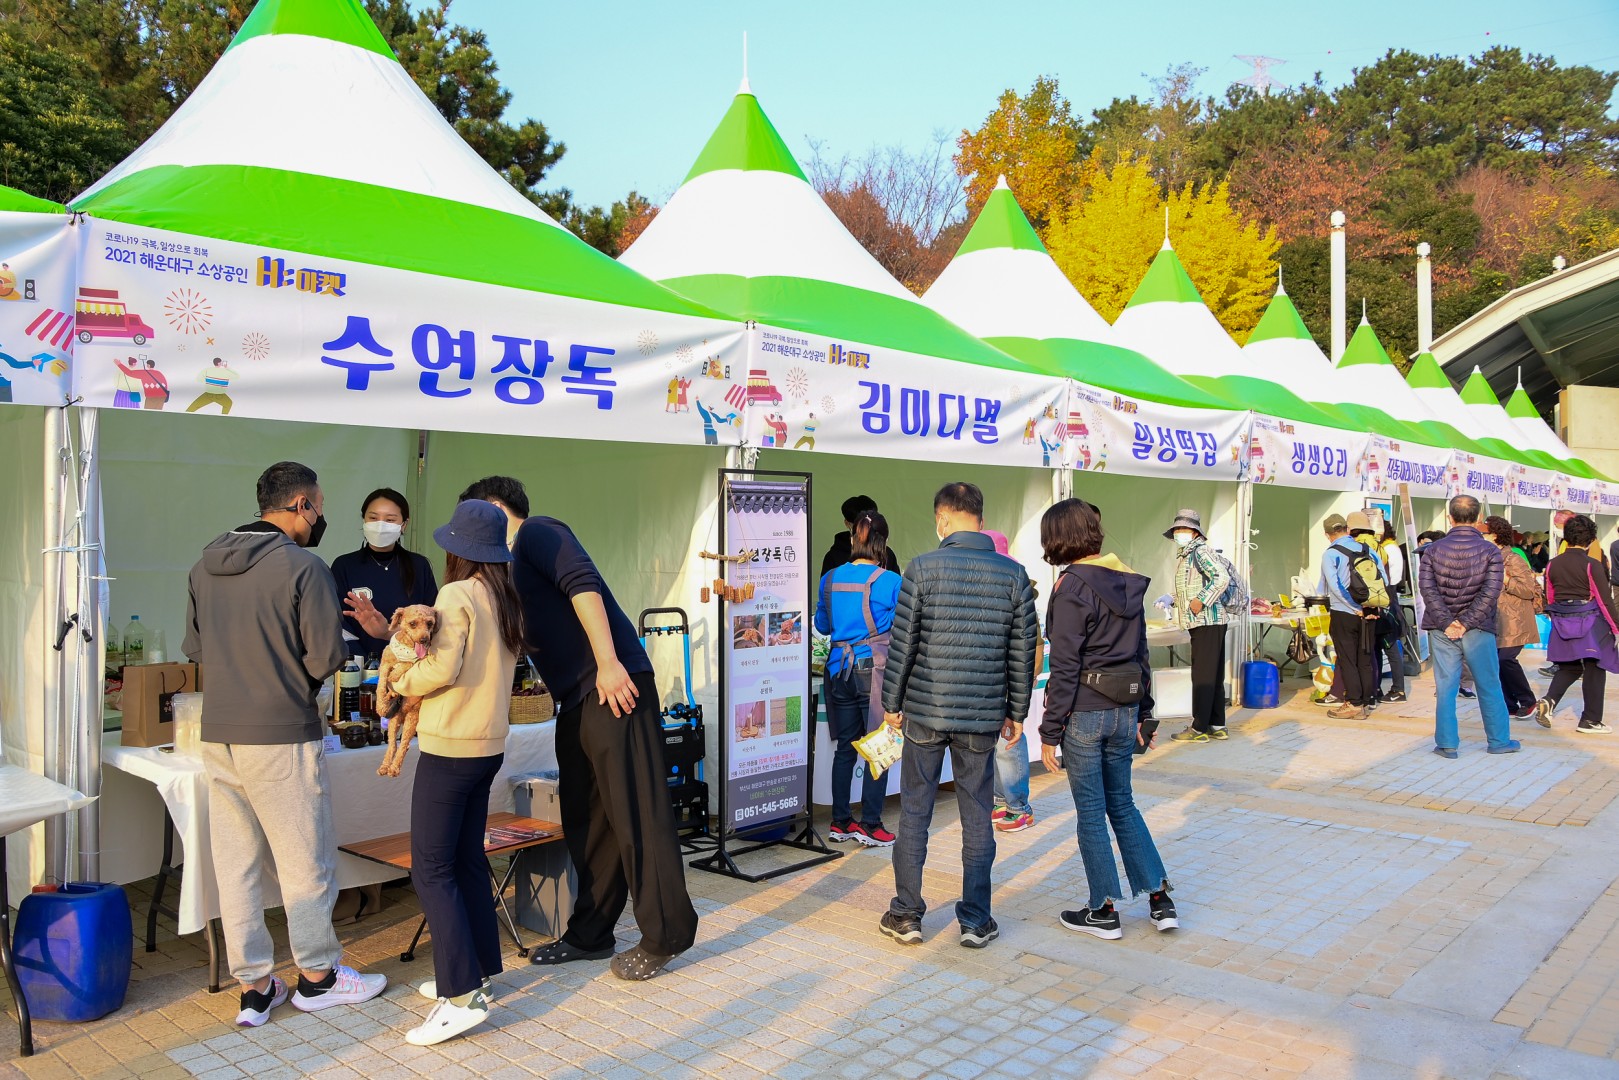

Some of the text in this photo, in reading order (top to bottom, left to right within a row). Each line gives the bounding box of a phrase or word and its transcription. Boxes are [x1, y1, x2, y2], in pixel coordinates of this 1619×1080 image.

[105, 232, 209, 258] 코로나19 극복, 일상으로 회복
[105, 247, 137, 265] 2021
[139, 252, 194, 275] 해운대구
[196, 262, 249, 284] 소상공인
[320, 315, 617, 410] 수연장독
[761, 341, 777, 353] 2021
[777, 344, 802, 359] 해운대구
[802, 350, 826, 363] 소상공인
[858, 380, 1001, 445] 김미다멸
[1131, 421, 1218, 467] 일성떡집
[1291, 441, 1348, 478] 생생오리
[738, 547, 782, 563] 연장독
[745, 796, 798, 817] 051-545-5665
